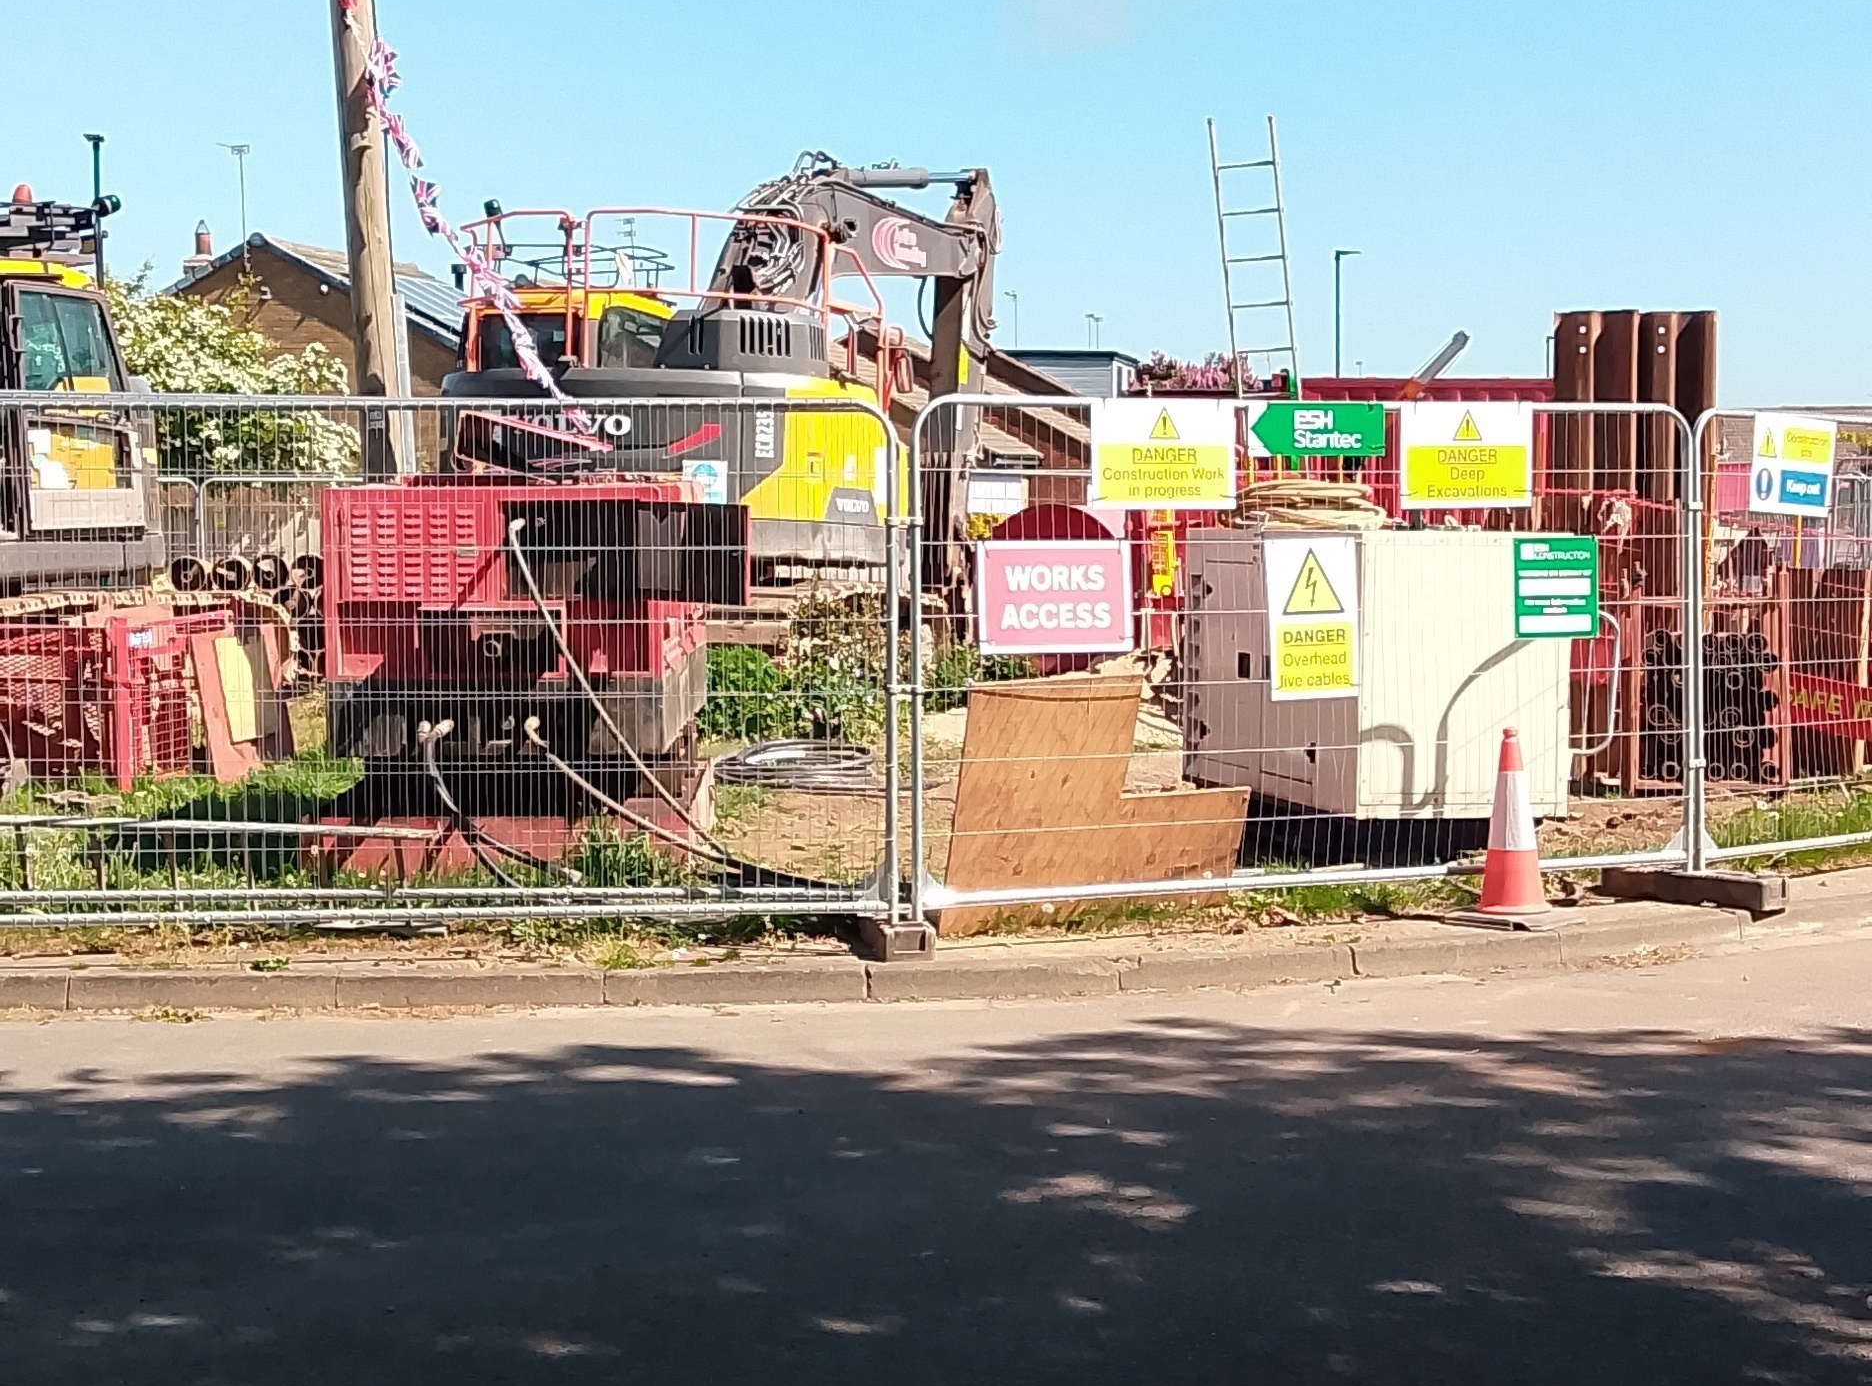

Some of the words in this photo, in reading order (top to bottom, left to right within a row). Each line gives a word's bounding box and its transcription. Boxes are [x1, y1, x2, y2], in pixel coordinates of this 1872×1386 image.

[1293, 409, 1333, 429] ESH
[1293, 430, 1362, 448] Stantec
[1132, 448, 1197, 463] DANGER
[1437, 449, 1497, 463] DANGER
[1103, 467, 1192, 481] Construction
[1193, 467, 1225, 481] Work
[1450, 467, 1485, 482] Deep
[1128, 484, 1140, 496] in
[1144, 486, 1201, 499] progress
[1427, 485, 1507, 498] Excavations
[835, 498, 870, 513] VOLVO
[1004, 564, 1106, 592] WORKS
[1000, 601, 1112, 630] ACCESS
[1283, 628, 1346, 644] DANGER
[1283, 651, 1347, 666] Overhead
[1280, 674, 1303, 688] live
[1307, 672, 1350, 687] cables
